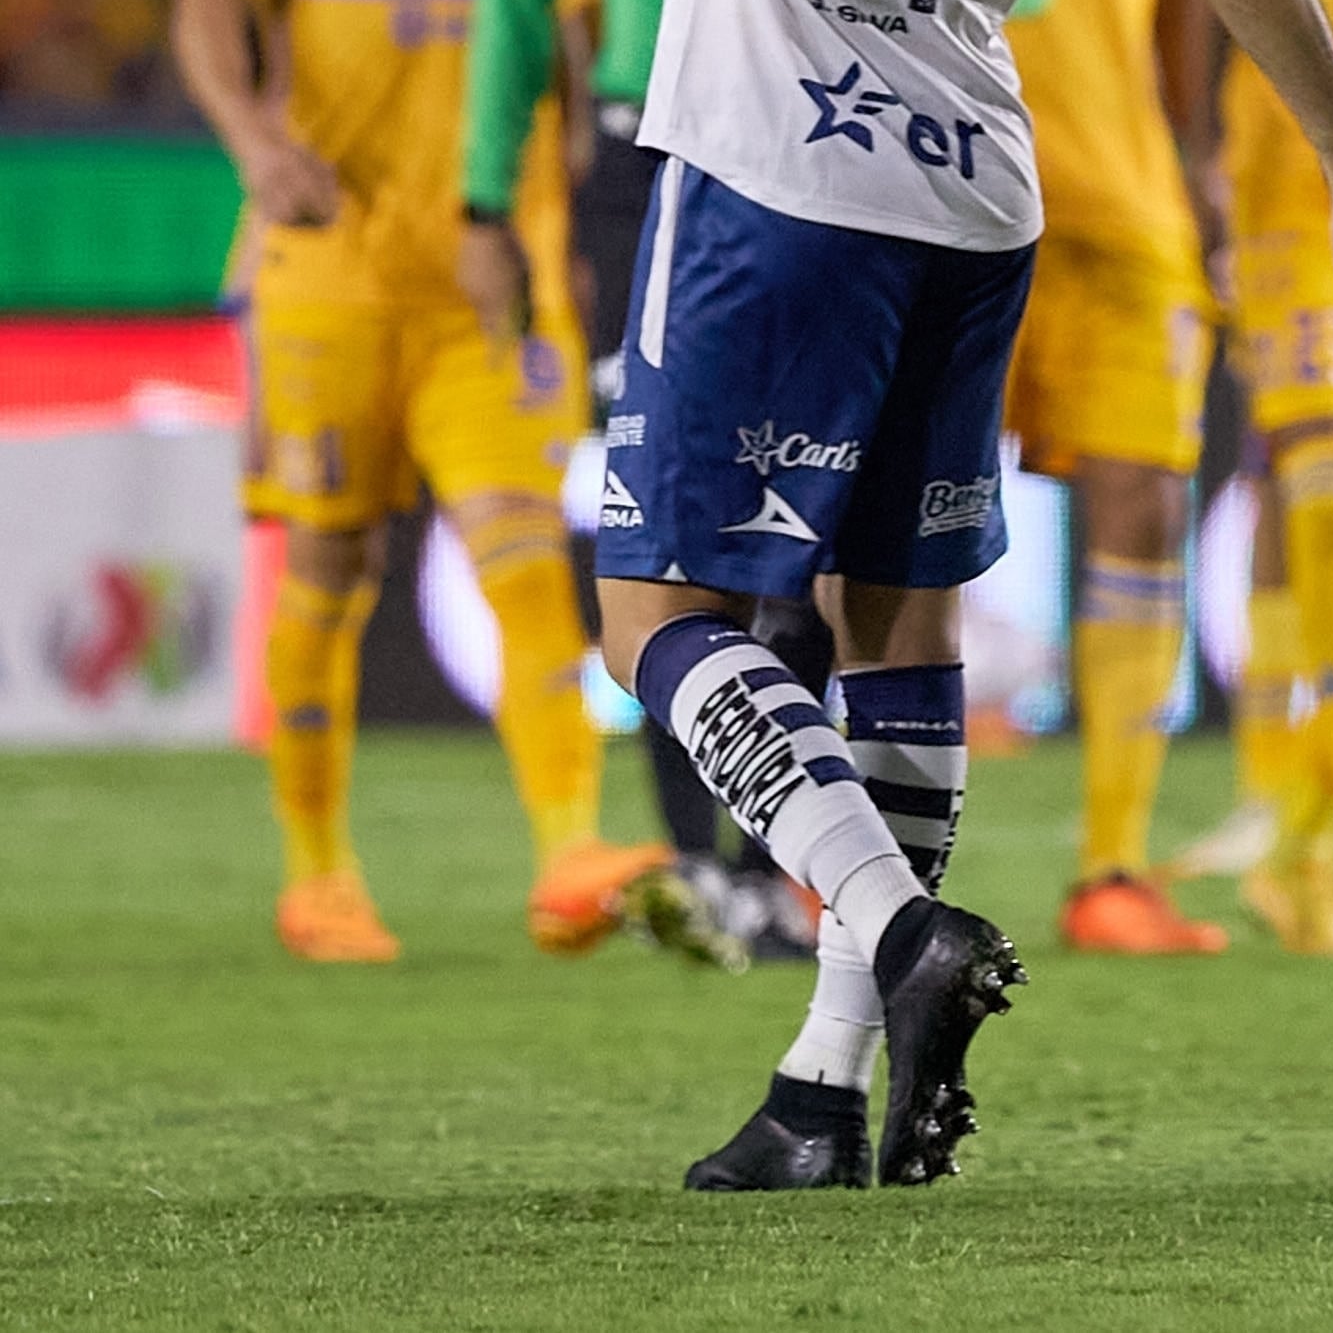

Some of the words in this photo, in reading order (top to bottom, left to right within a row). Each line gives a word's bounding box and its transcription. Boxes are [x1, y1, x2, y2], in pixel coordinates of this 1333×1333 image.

[907, 113, 986, 180] er
[777, 432, 862, 473] Carl's
[689, 676, 807, 837] PERDURA
